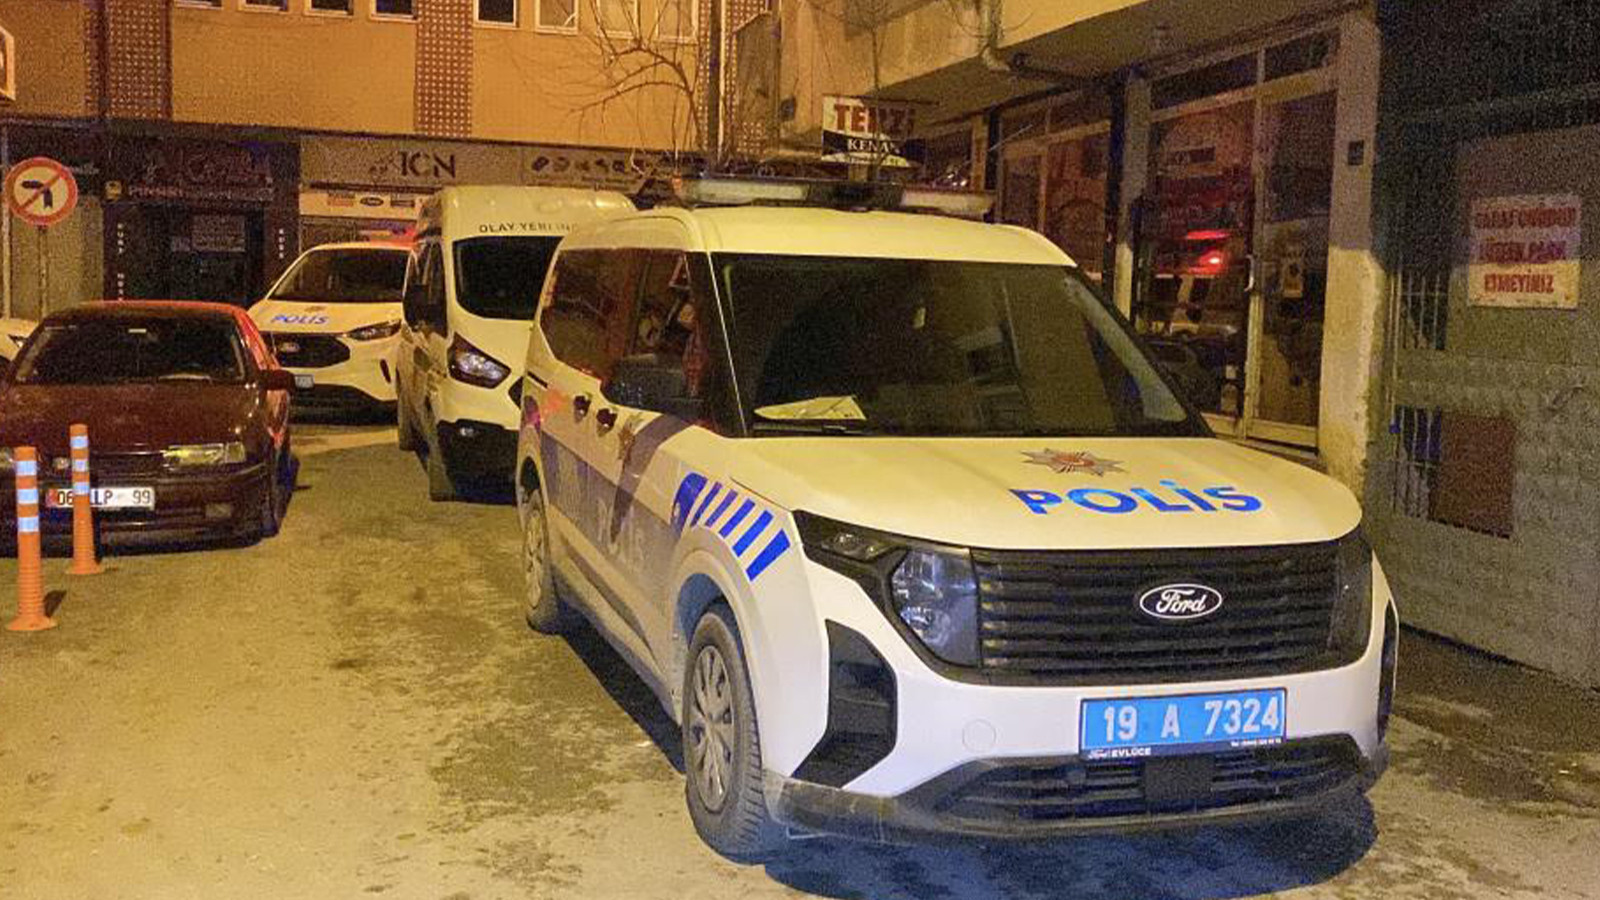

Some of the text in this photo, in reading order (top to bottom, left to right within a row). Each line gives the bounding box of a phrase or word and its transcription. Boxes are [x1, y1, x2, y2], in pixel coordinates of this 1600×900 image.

[479, 222, 514, 233] OLAY
[58, 489, 151, 506] 06 LP 99
[1008, 479, 1262, 514] POLİS
[1155, 589, 1208, 613] Ford
[1104, 696, 1280, 742] 19 A 7324
